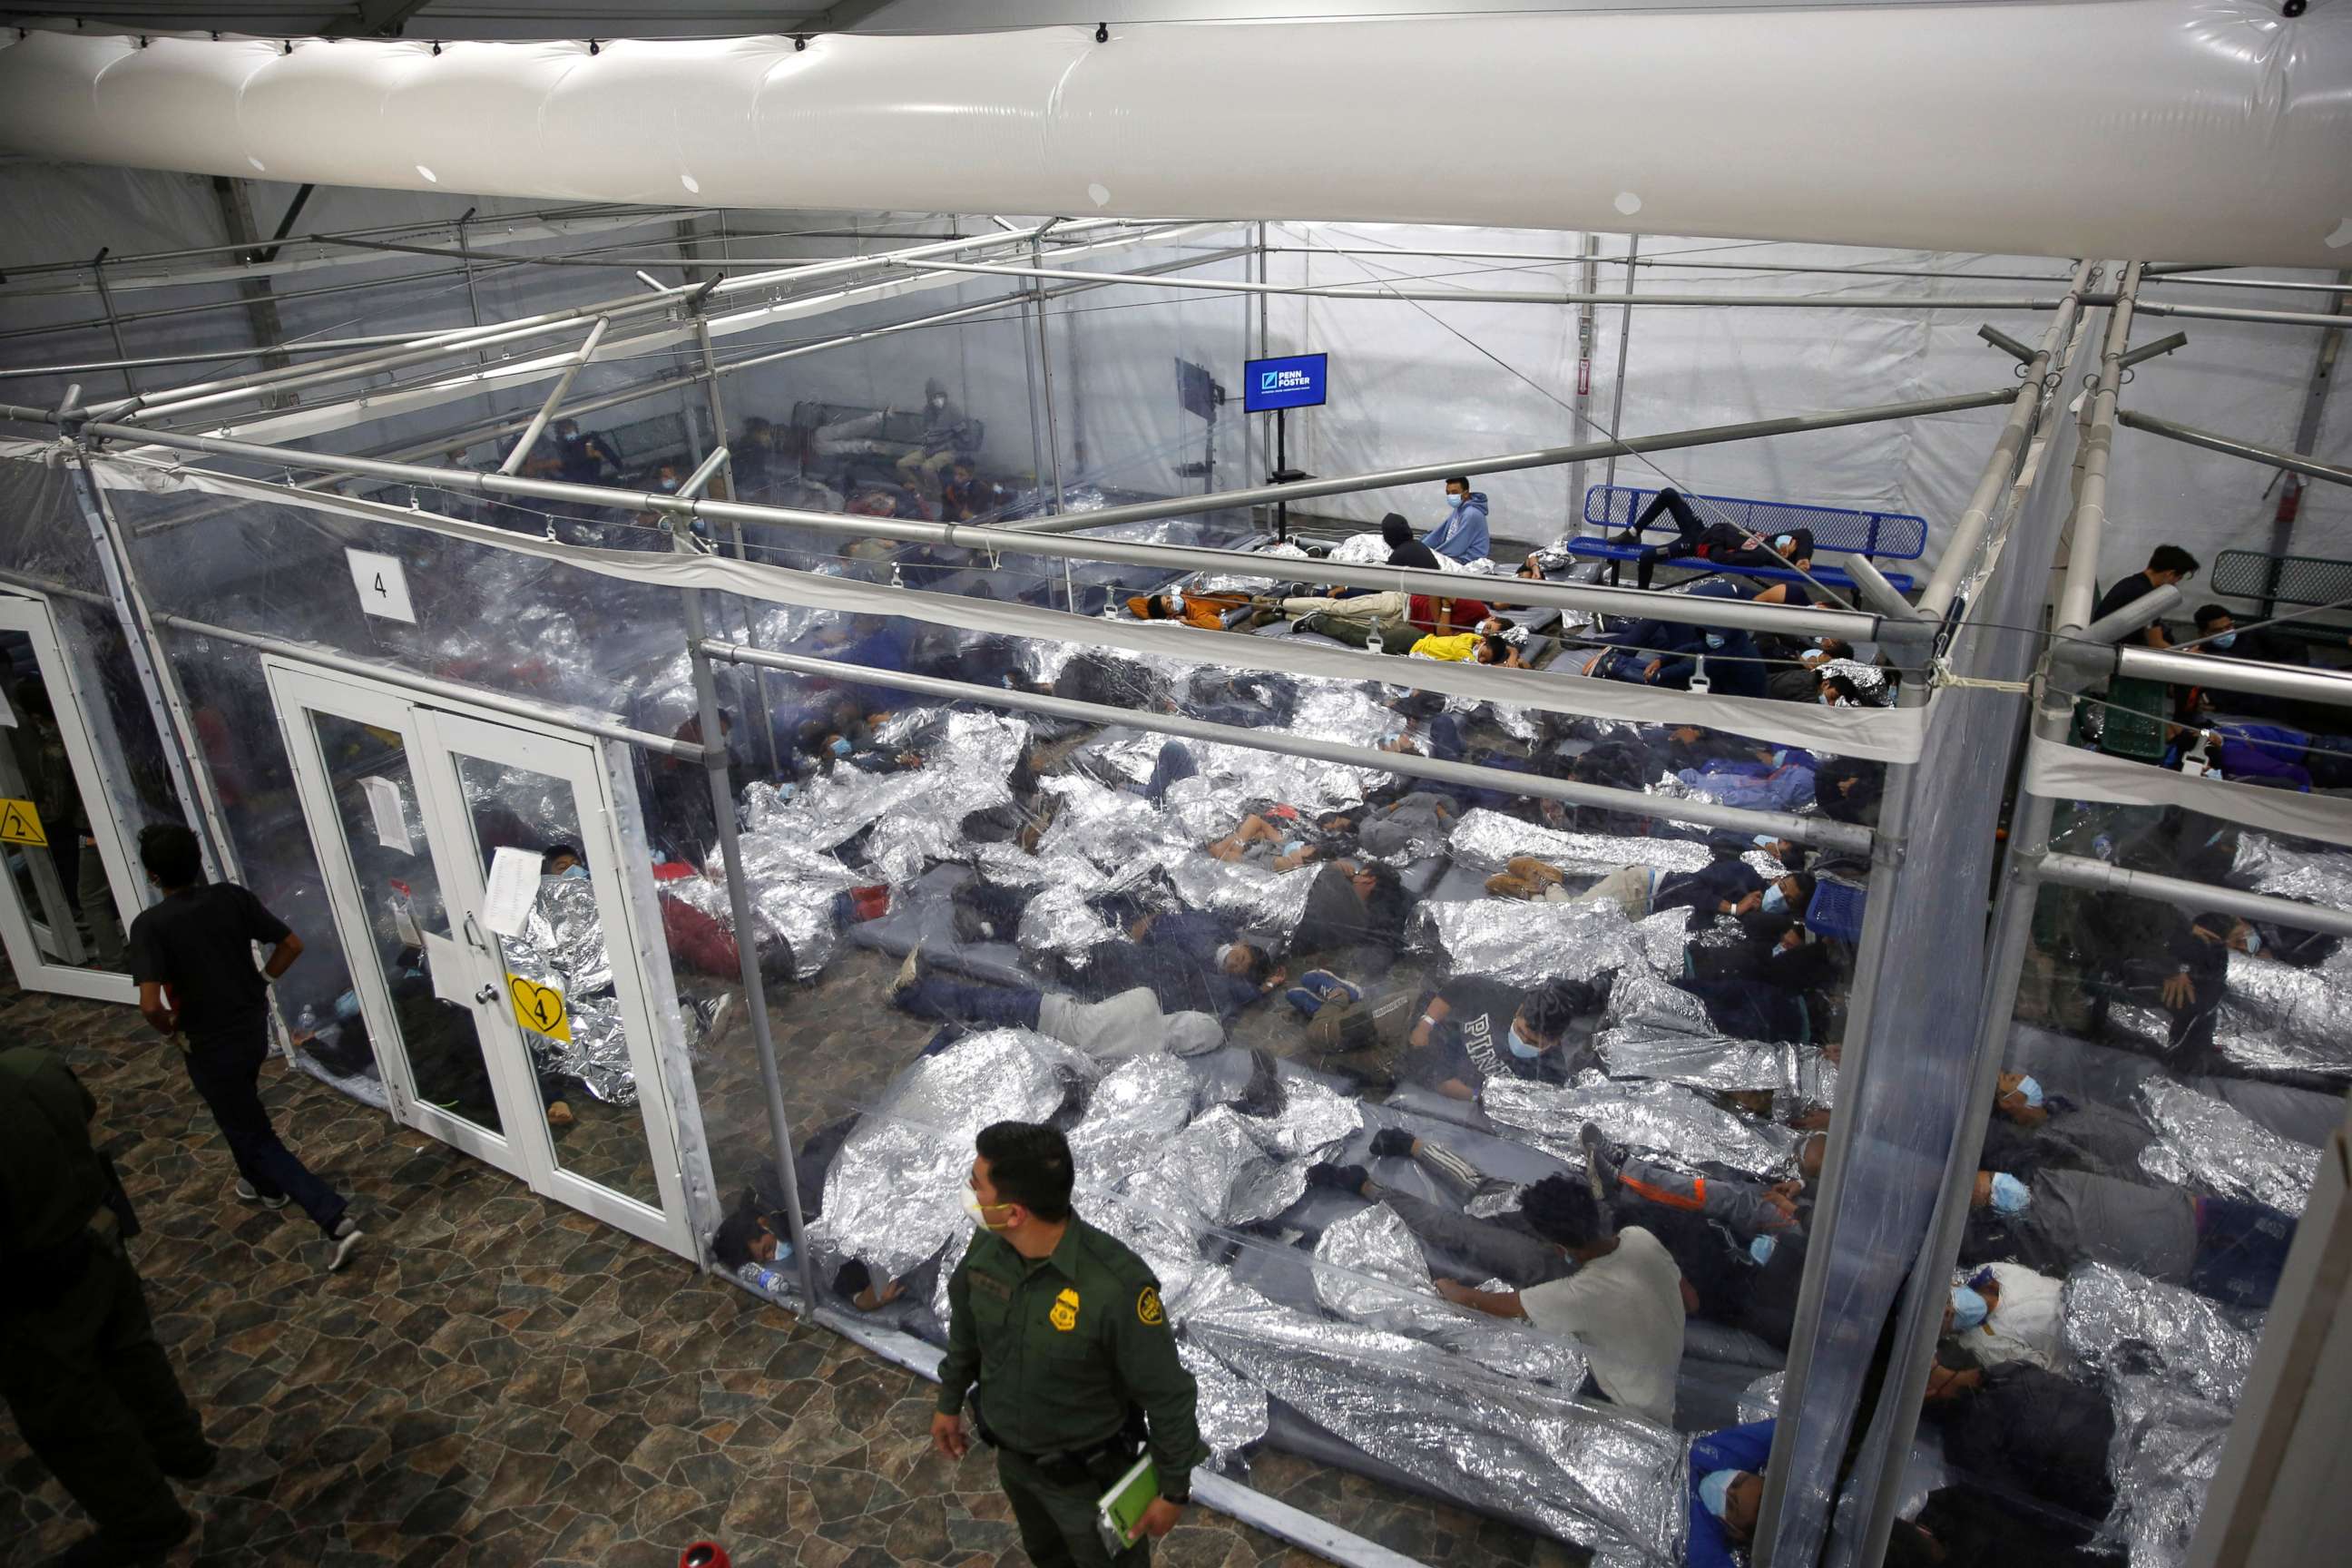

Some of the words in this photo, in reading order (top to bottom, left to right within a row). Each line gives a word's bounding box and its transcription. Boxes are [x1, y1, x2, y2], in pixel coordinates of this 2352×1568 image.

[1279, 370, 1302, 379] PENN
[1279, 377, 1310, 387] FOSTER
[375, 572, 387, 598] 4
[10, 815, 25, 836] 2
[534, 999, 548, 1024] 4
